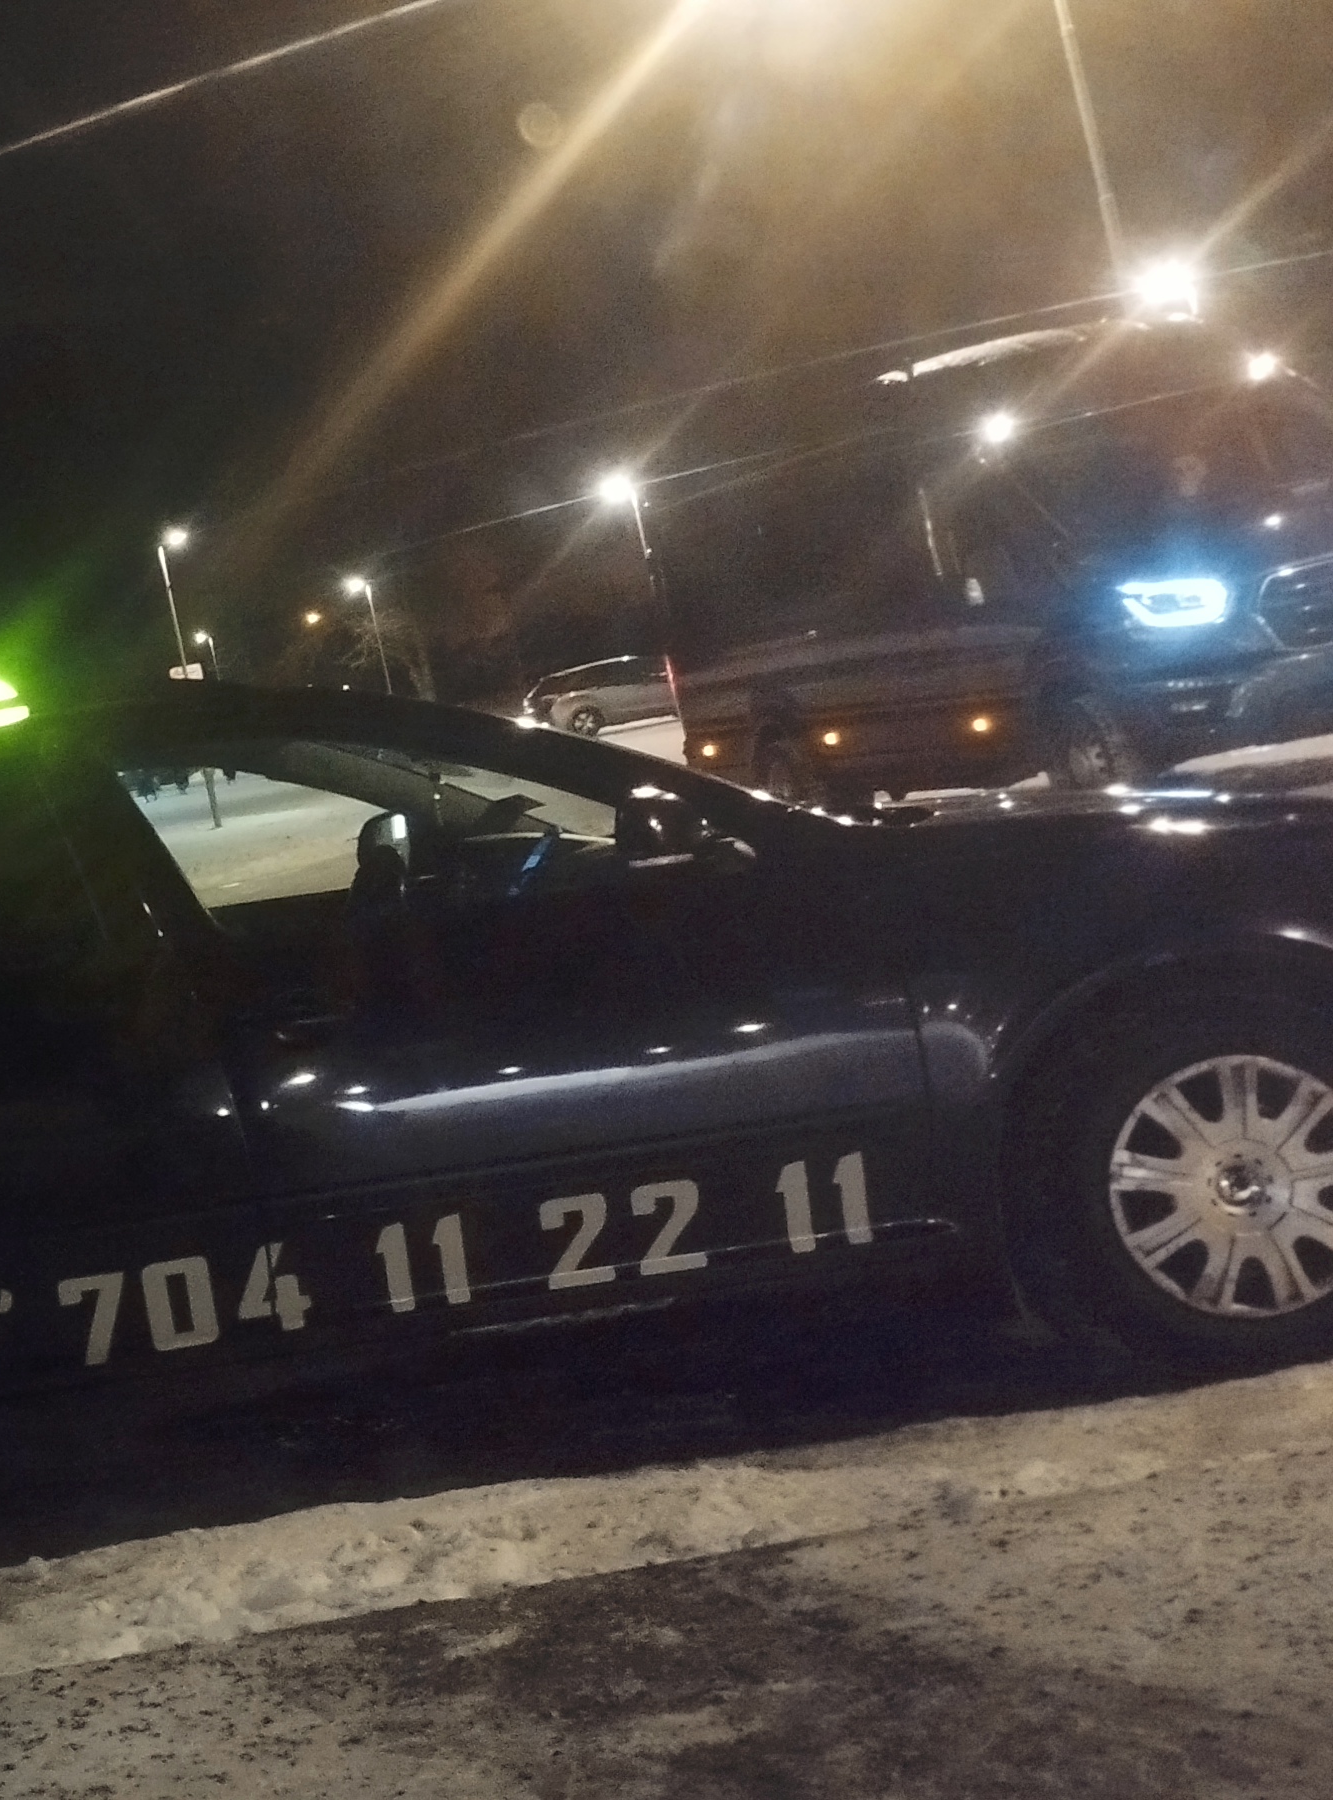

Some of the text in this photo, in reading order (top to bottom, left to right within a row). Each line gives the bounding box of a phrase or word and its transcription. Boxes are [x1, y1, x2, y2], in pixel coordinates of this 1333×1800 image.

[58, 1151, 873, 1365] 704 11 22 11
